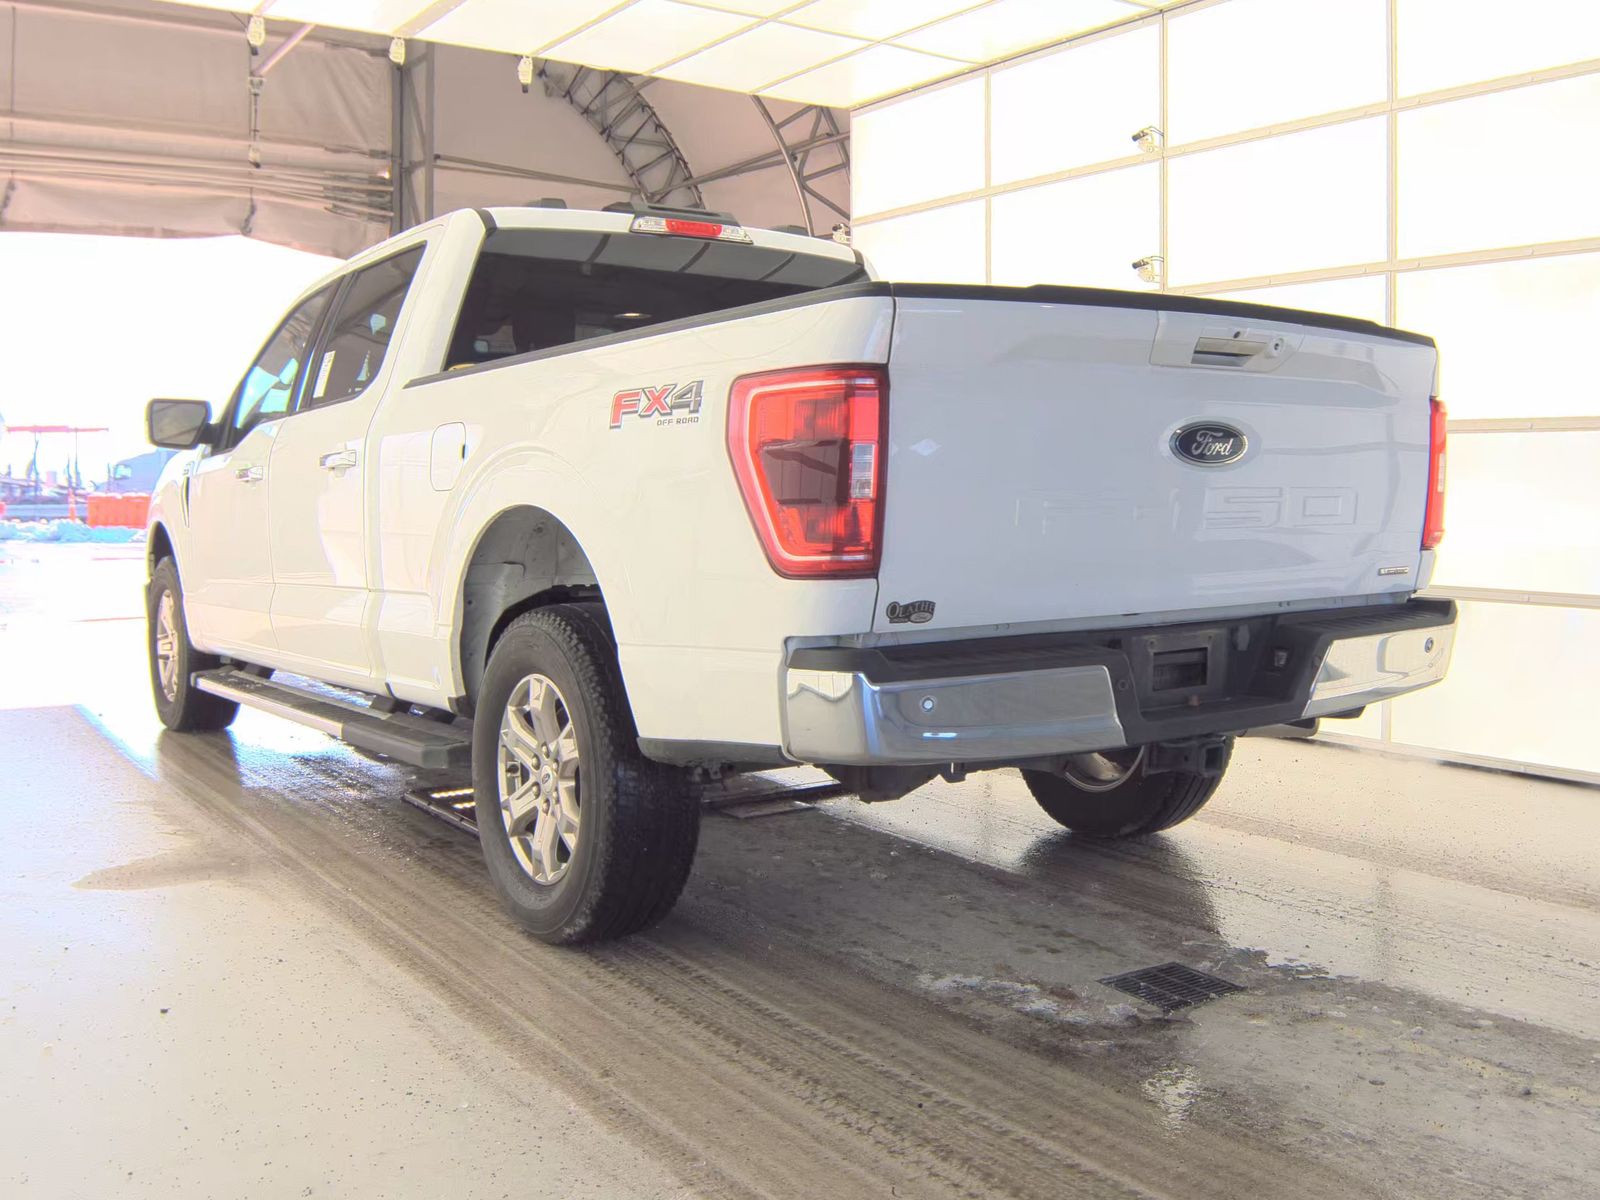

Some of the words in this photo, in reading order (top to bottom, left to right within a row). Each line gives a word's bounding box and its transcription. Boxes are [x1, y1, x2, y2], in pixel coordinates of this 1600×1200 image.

[609, 379, 704, 430] FX4
[656, 418, 674, 427] OFF
[675, 416, 700, 426] ROAD
[1191, 429, 1235, 456] Ford
